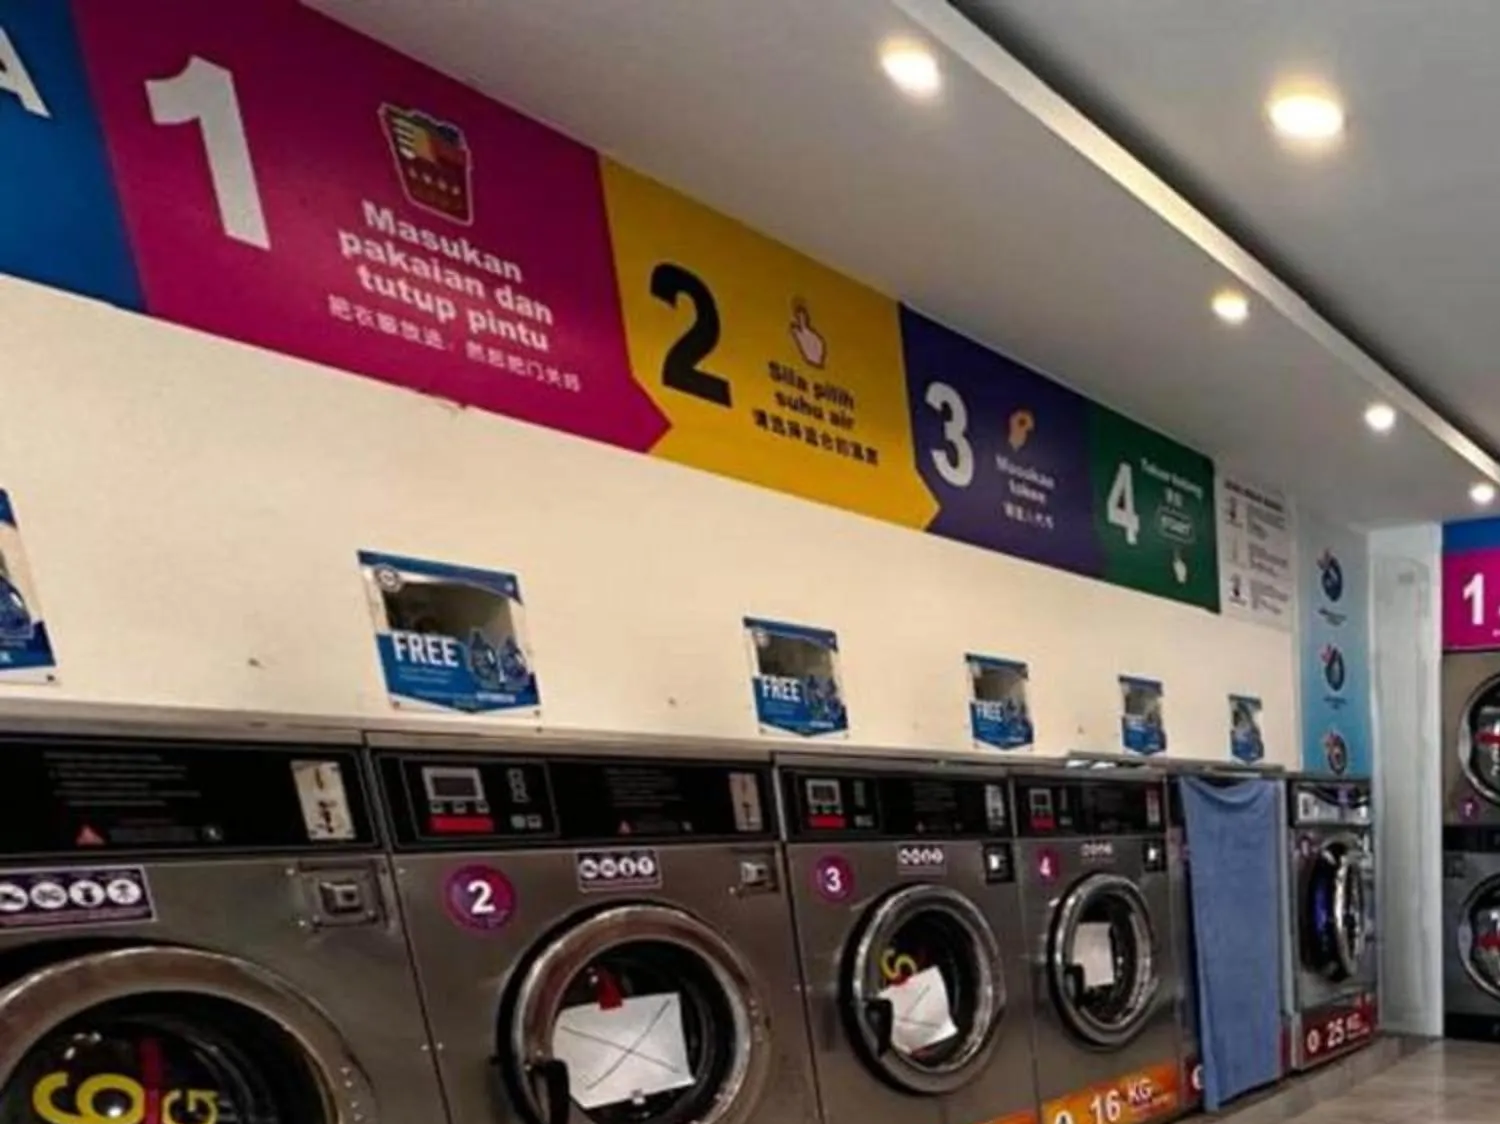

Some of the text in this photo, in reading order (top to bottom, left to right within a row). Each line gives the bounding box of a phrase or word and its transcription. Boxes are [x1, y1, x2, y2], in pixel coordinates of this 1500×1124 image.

[144, 55, 271, 250] 1
[361, 198, 523, 284] Masukan
[337, 228, 554, 326] pakaian dan
[356, 263, 550, 353] tutup pintu
[649, 261, 733, 409] 2
[768, 360, 854, 411] Sila pilih
[774, 391, 854, 430] suhu air
[925, 381, 974, 488] 3
[1107, 462, 1139, 544] 4
[1462, 572, 1484, 625] 1
[391, 631, 459, 668] FREE
[761, 675, 801, 701] FREE
[467, 880, 496, 914] 2
[825, 867, 841, 892] 3
[1127, 1078, 1151, 1103] KG
